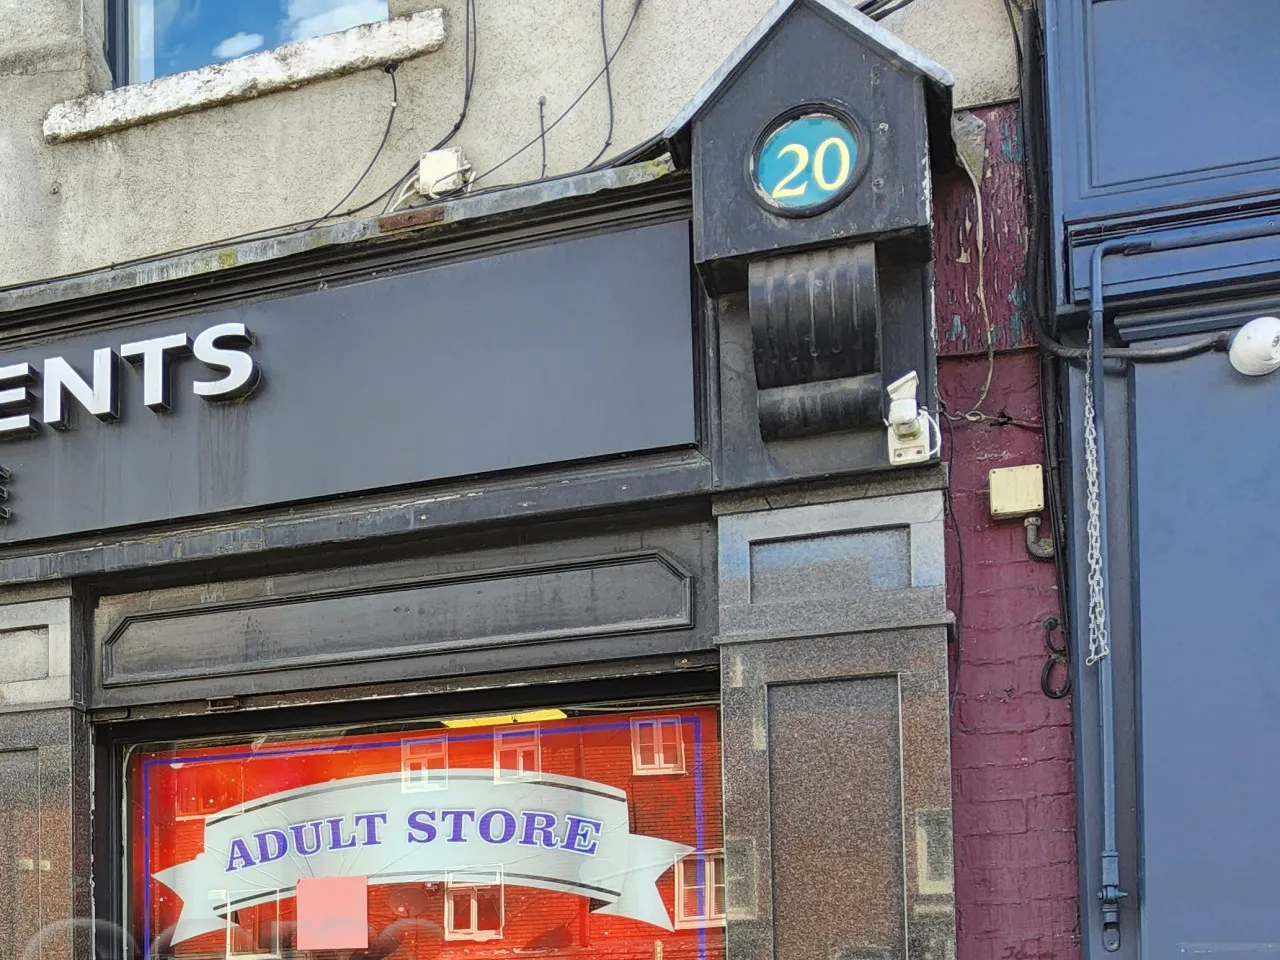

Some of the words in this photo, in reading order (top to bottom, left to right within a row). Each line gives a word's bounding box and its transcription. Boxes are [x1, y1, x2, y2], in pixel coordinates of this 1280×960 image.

[772, 137, 850, 199] 20
[225, 810, 388, 873] ADULT
[407, 808, 604, 857] STORE
